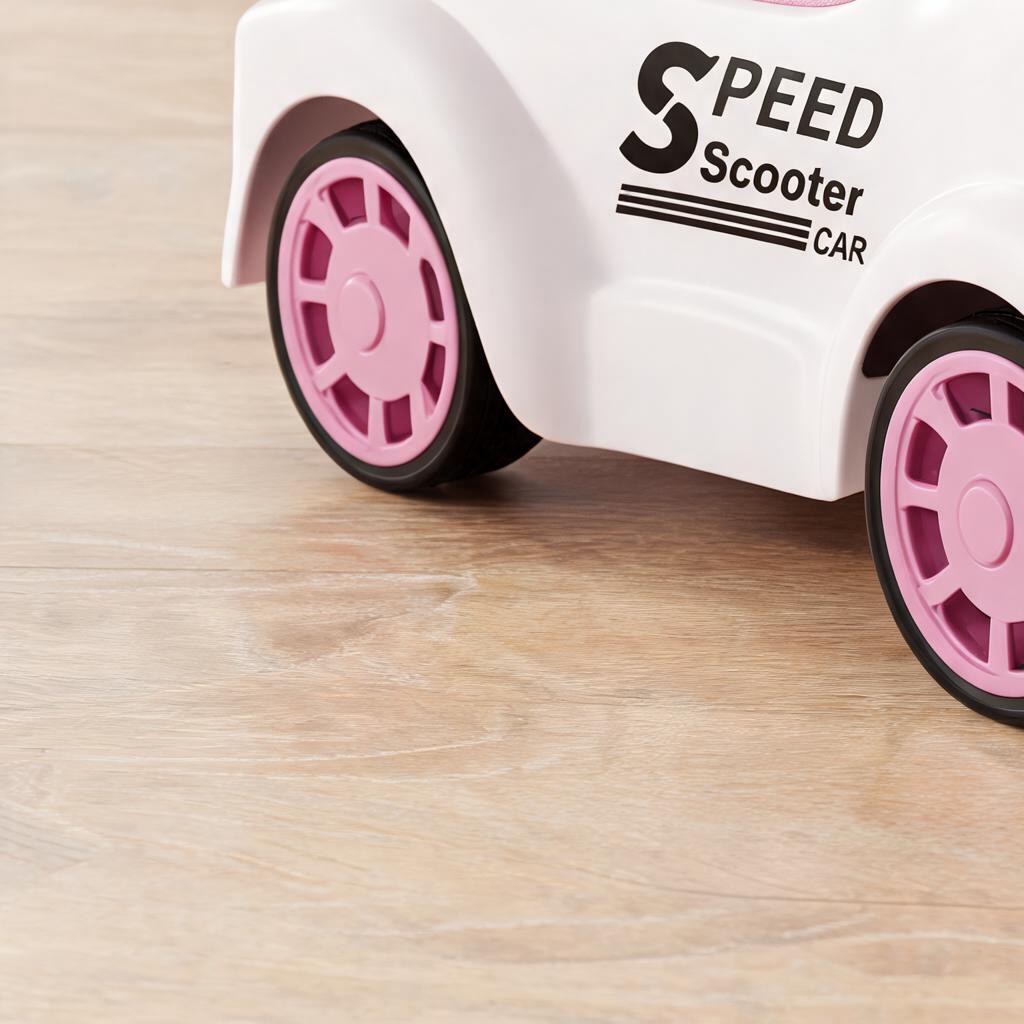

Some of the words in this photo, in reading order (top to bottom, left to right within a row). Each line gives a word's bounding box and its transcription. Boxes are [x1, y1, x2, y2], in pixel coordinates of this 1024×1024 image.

[618, 41, 884, 174] SPEED
[699, 140, 865, 216] Scooter
[813, 226, 868, 265] CAR
